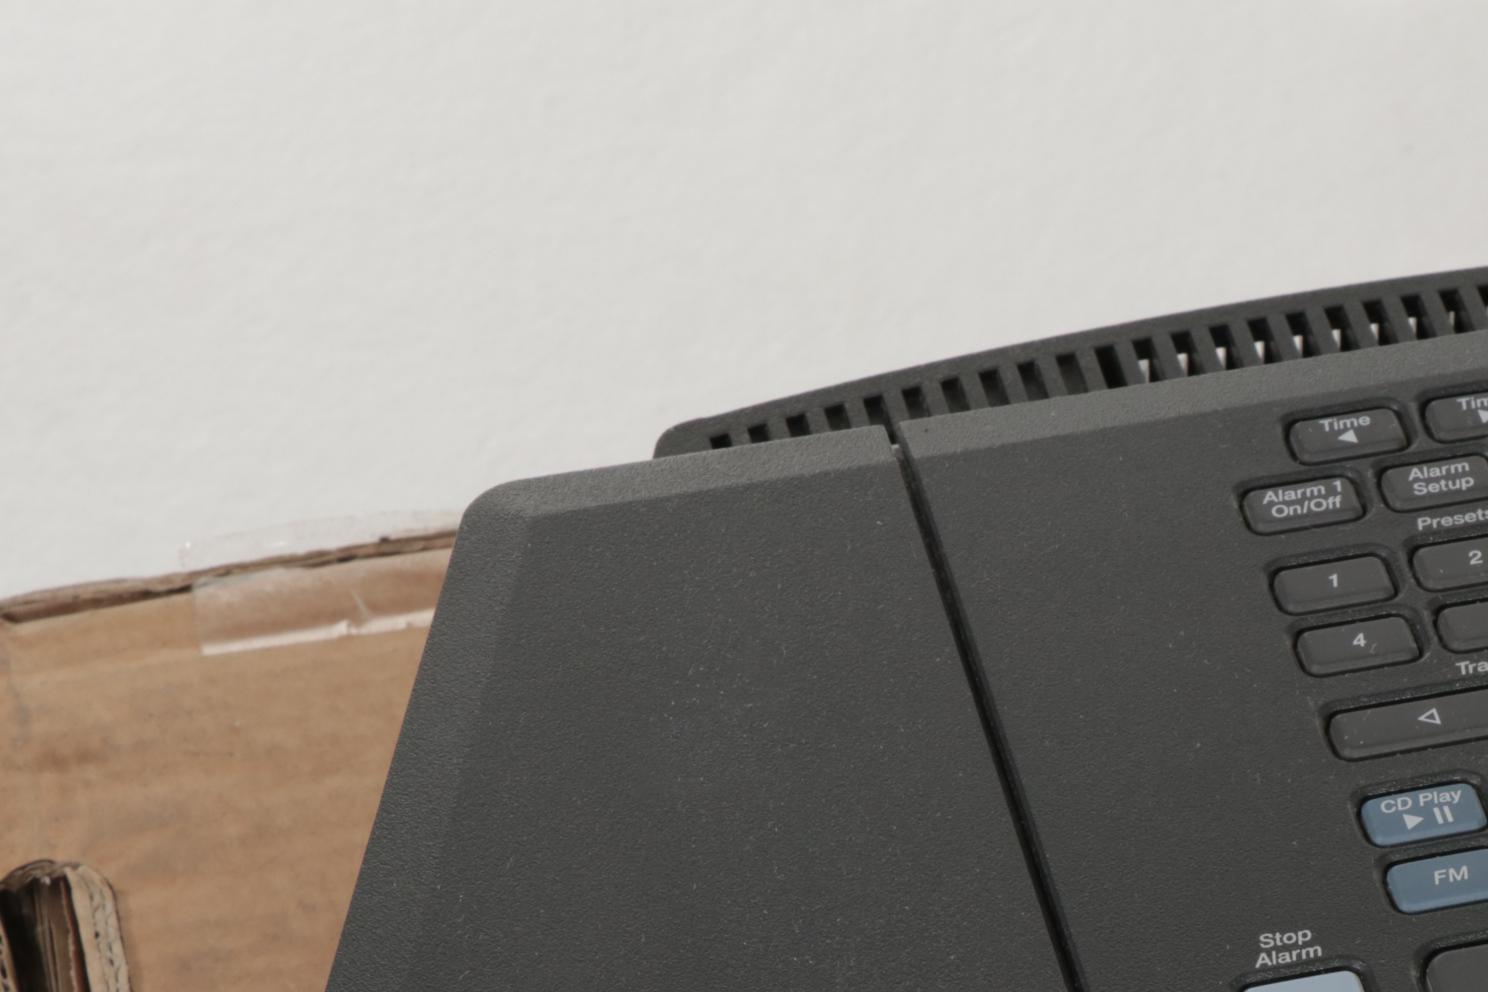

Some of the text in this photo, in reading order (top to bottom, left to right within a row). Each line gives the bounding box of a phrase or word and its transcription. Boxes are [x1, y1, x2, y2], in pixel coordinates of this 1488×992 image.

[1319, 414, 1371, 433] Time
[1408, 461, 1469, 481] Alarm
[1263, 480, 1343, 504] Alarm 1
[1413, 475, 1475, 495] Setup
[1272, 495, 1343, 518] On/Off
[1468, 550, 1482, 565] 2
[1329, 574, 1339, 588] 1
[1352, 632, 1367, 648] 4
[1380, 788, 1462, 814] CD Play
[1433, 865, 1469, 885] FM
[1259, 928, 1312, 950] Stop
[1254, 942, 1323, 969] Alarm
